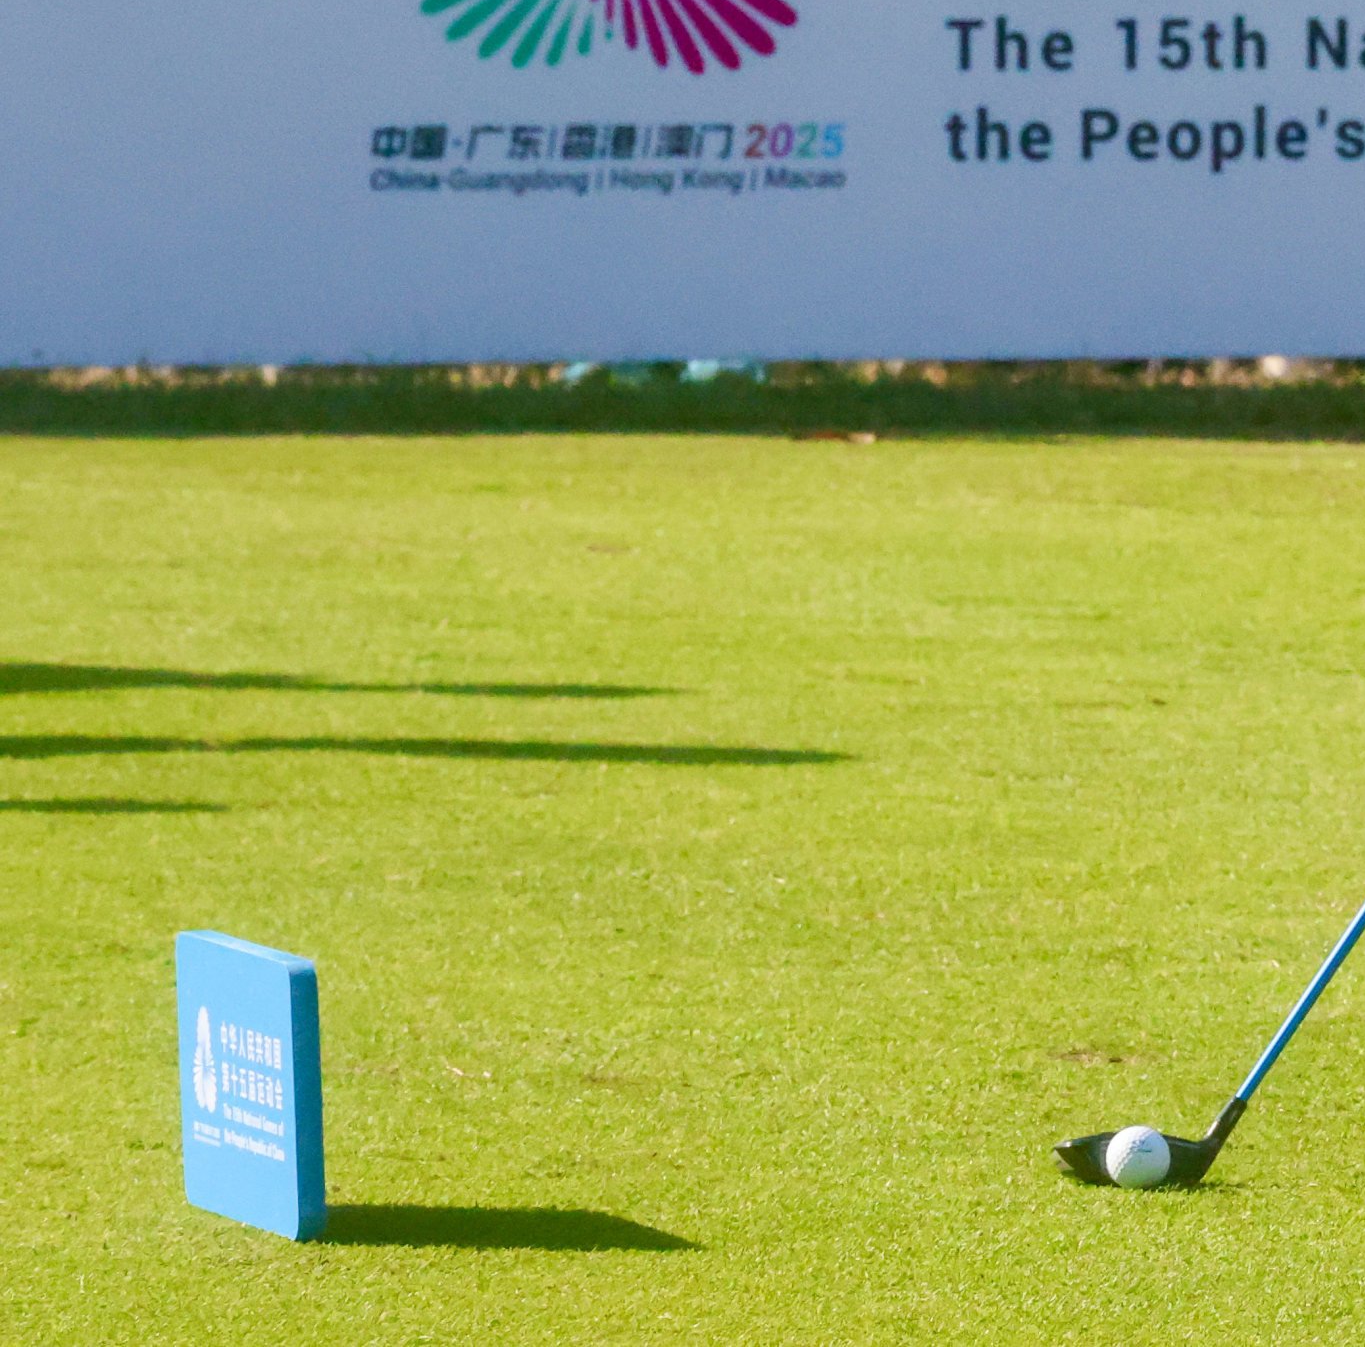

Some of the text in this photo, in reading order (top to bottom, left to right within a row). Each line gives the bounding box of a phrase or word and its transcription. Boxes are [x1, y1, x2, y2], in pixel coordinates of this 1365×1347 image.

[945, 15, 1075, 73] The
[1115, 14, 1268, 72] 15th
[744, 121, 846, 160] 2025
[944, 106, 1053, 163] the
